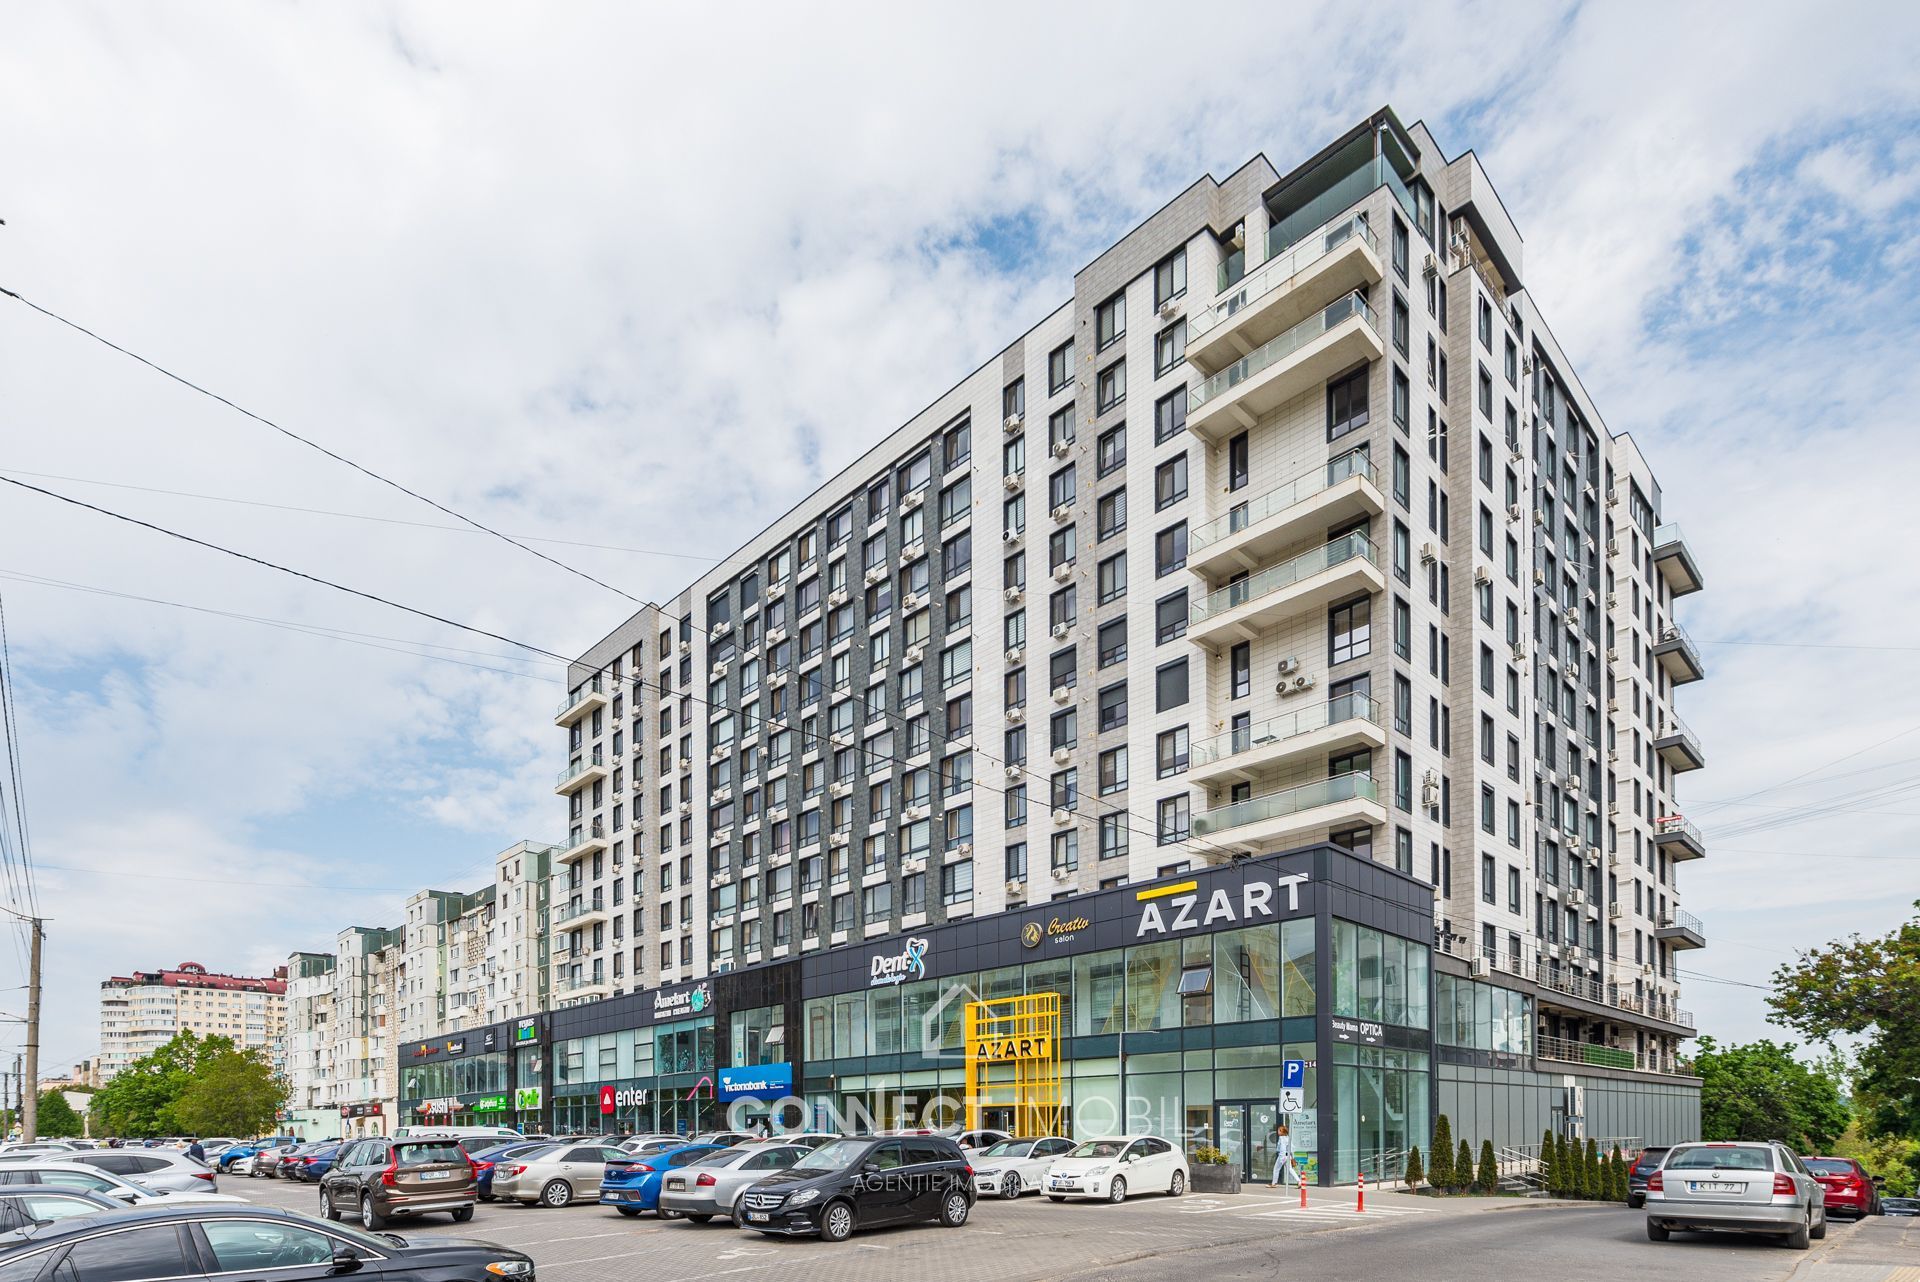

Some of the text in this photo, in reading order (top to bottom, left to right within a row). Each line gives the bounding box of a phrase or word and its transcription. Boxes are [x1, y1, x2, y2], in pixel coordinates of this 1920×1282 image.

[1136, 872, 1309, 937] AZART
[1054, 934, 1075, 944] salon
[1360, 1022, 1383, 1037] OPTICA
[977, 1038, 1048, 1061] AZART
[1287, 1063, 1299, 1080] P
[615, 1086, 648, 1107] enter
